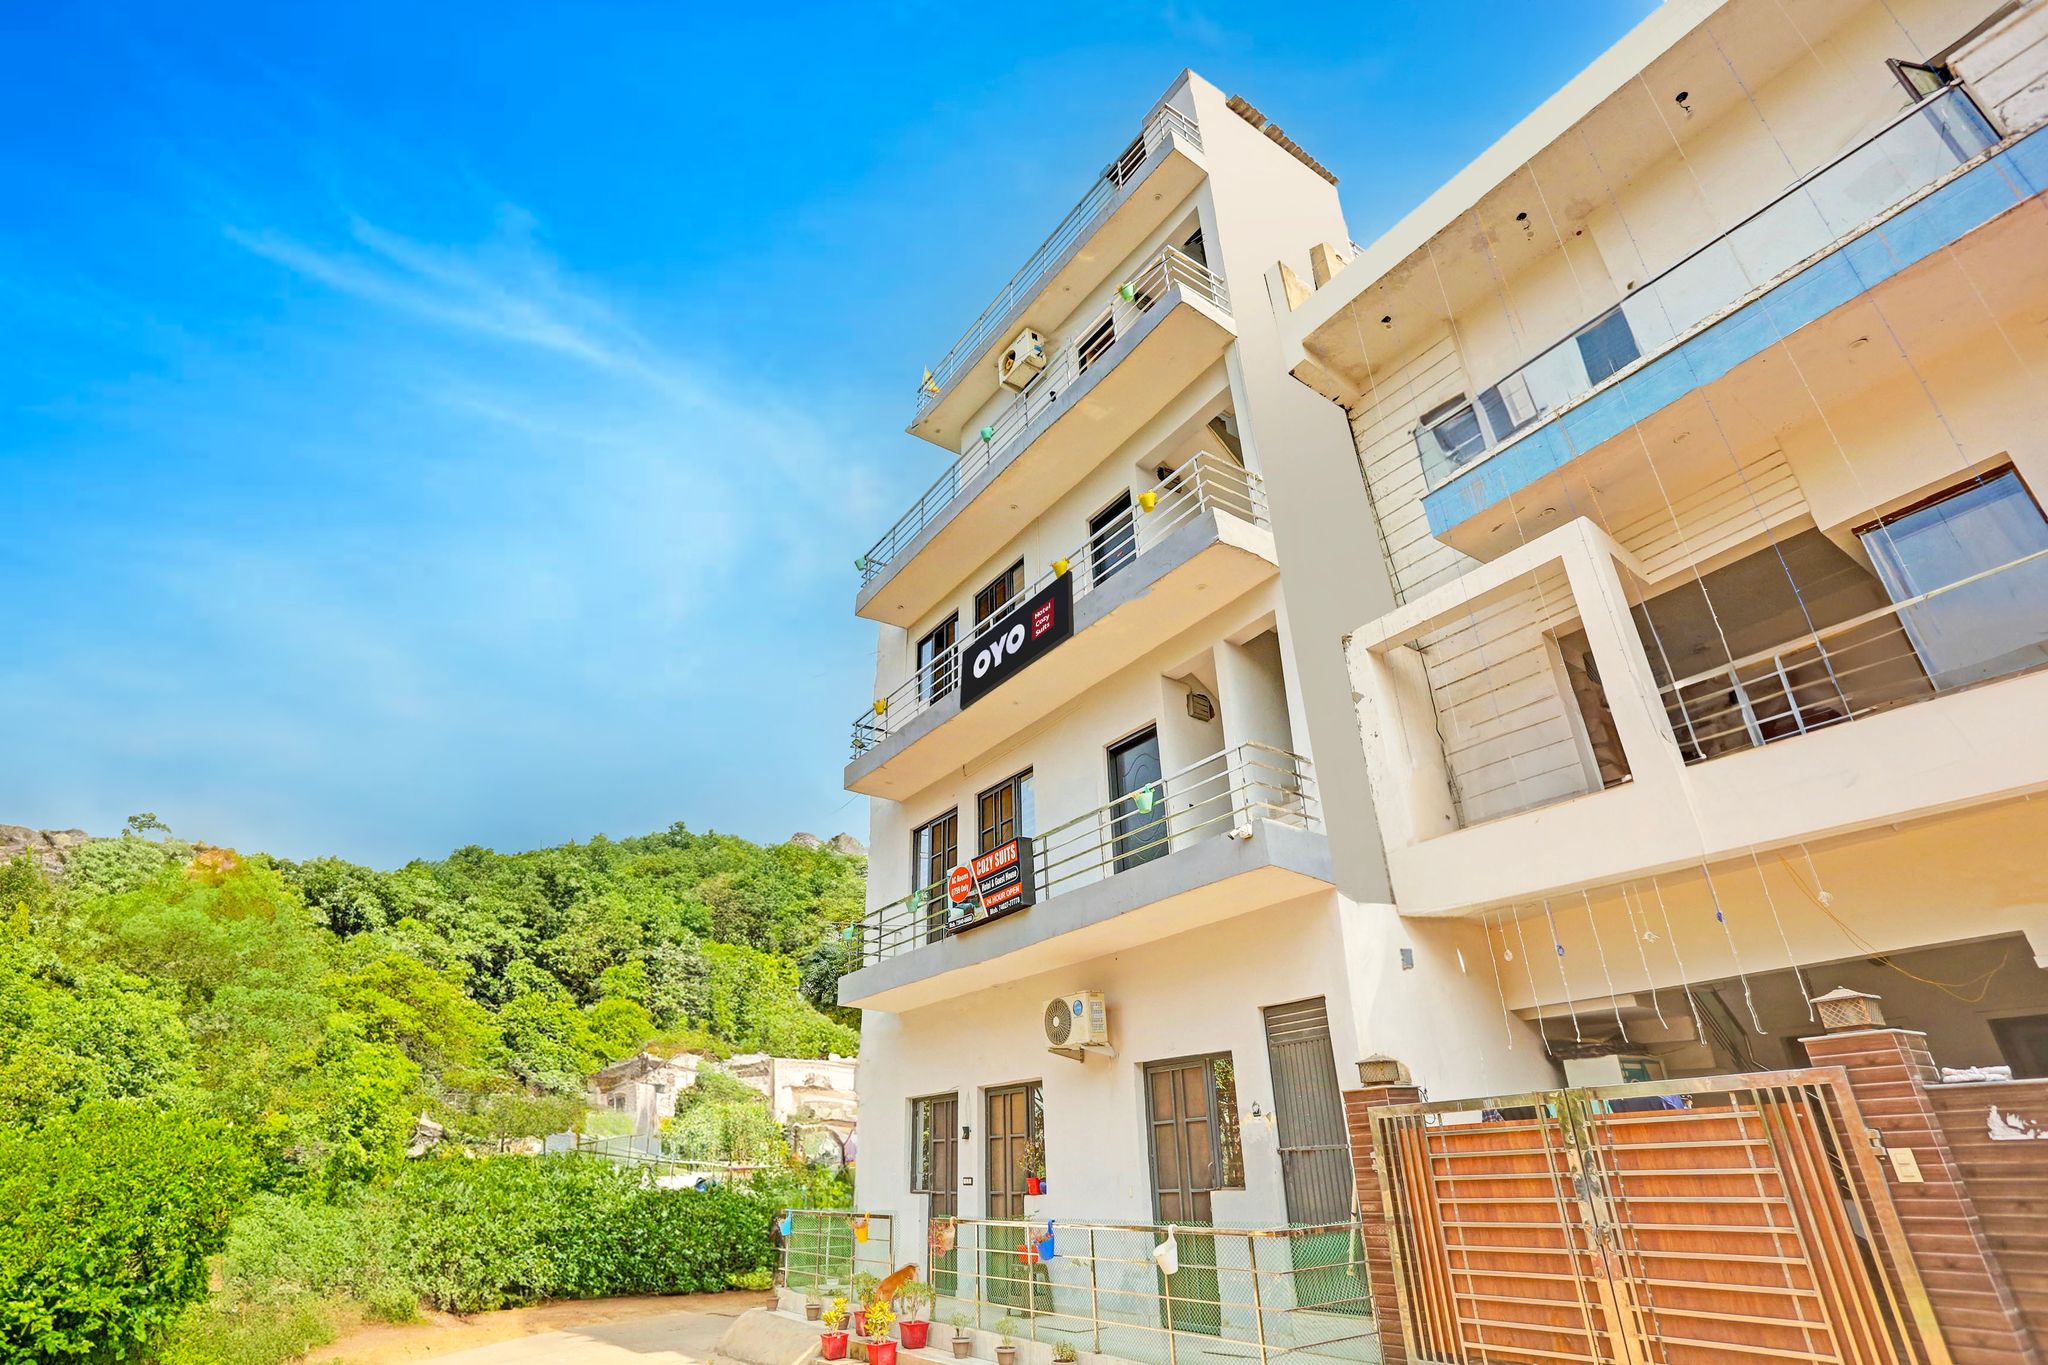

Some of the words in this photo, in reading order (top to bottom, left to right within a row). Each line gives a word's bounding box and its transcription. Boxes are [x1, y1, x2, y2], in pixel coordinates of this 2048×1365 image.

[1034, 602, 1051, 619] Hotel
[1035, 614, 1050, 628] Cozy
[1035, 622, 1051, 637] Suits
[973, 623, 1026, 679] OYO
[976, 855, 993, 876] COZY
[994, 844, 1016, 867] SUITS
[992, 891, 1005, 902] HOUR
[1006, 885, 1020, 897] OPEN
